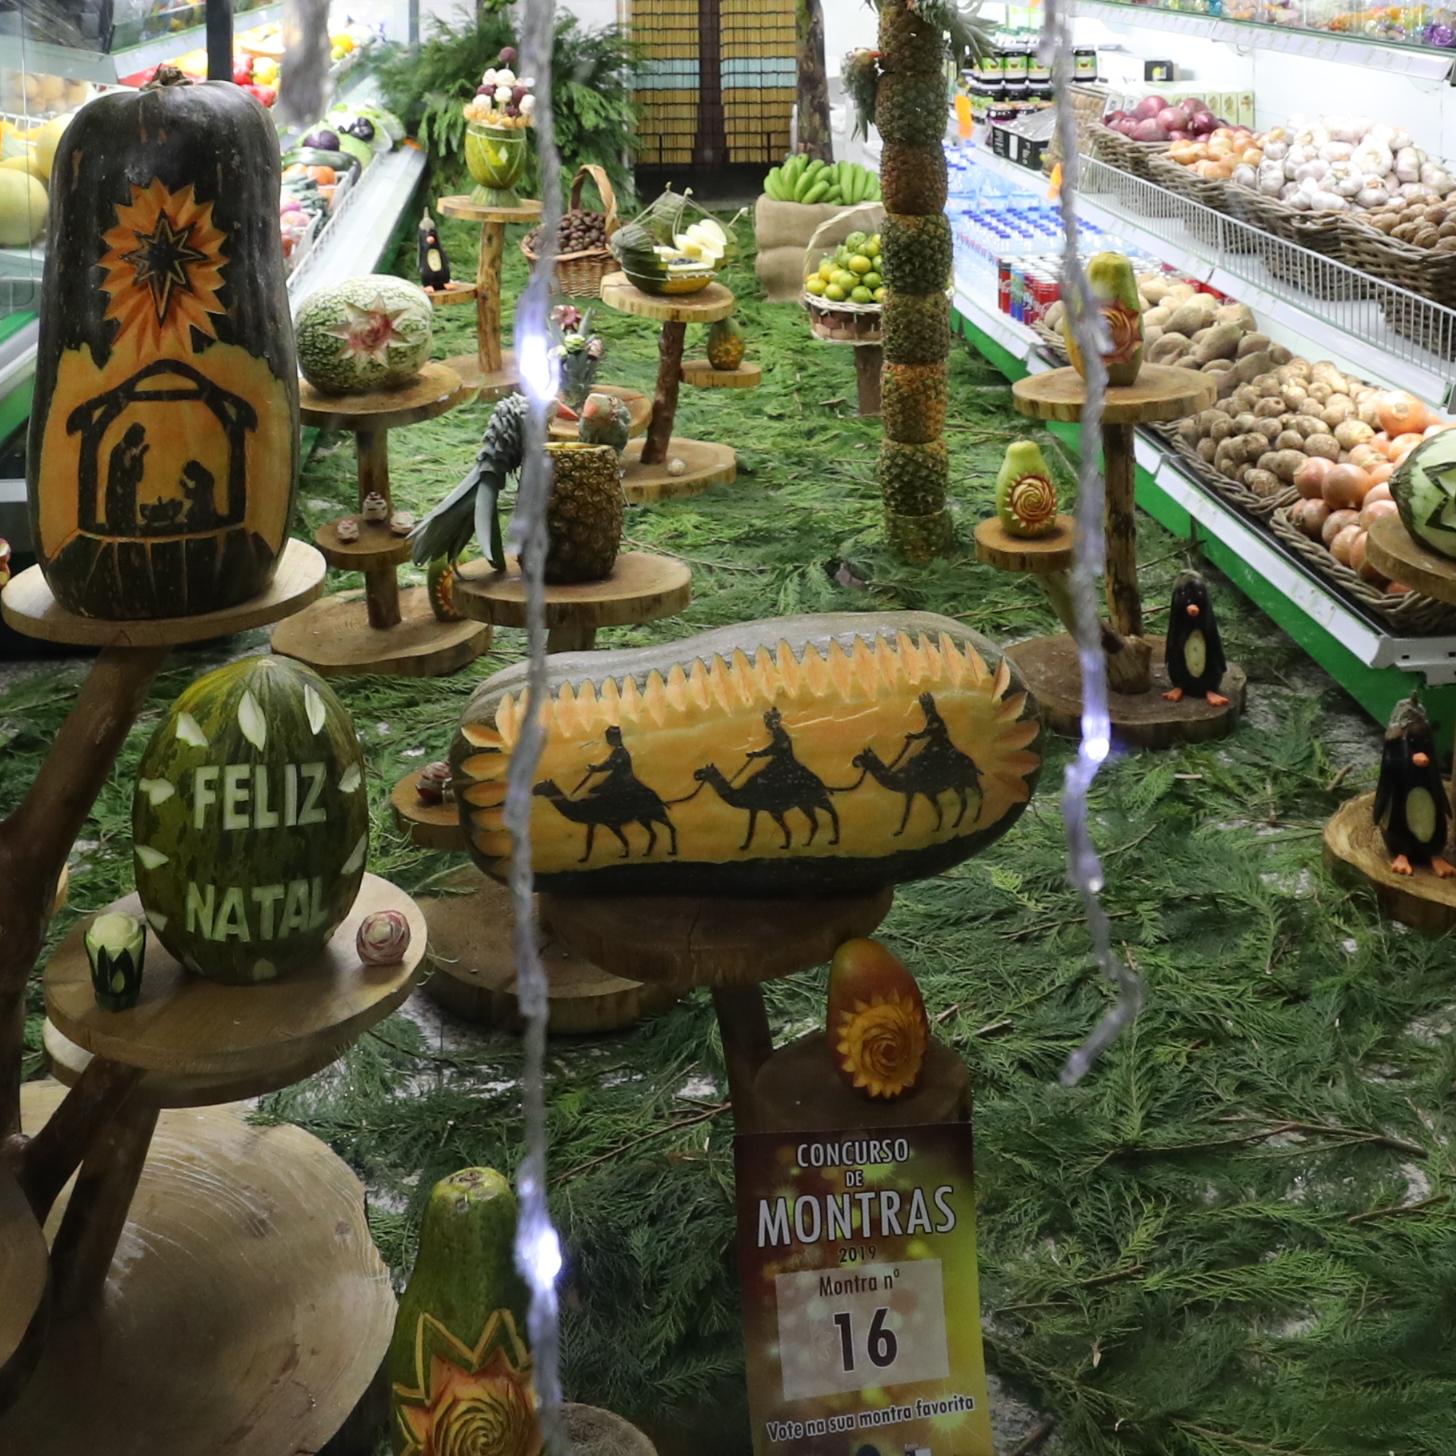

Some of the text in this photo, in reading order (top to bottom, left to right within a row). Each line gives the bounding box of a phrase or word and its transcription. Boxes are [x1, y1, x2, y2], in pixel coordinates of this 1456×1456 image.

[194, 761, 327, 830] FELIZ
[186, 877, 330, 943] NATAL
[796, 1137, 910, 1169] CONCURSO
[845, 1170, 864, 1188] DE
[756, 1185, 957, 1249] MONTRAS
[838, 1245, 878, 1264] 2019
[819, 1275, 878, 1298] Montra
[832, 1306, 899, 1374] 16
[767, 1393, 975, 1443] Vote na sua montra favorita
